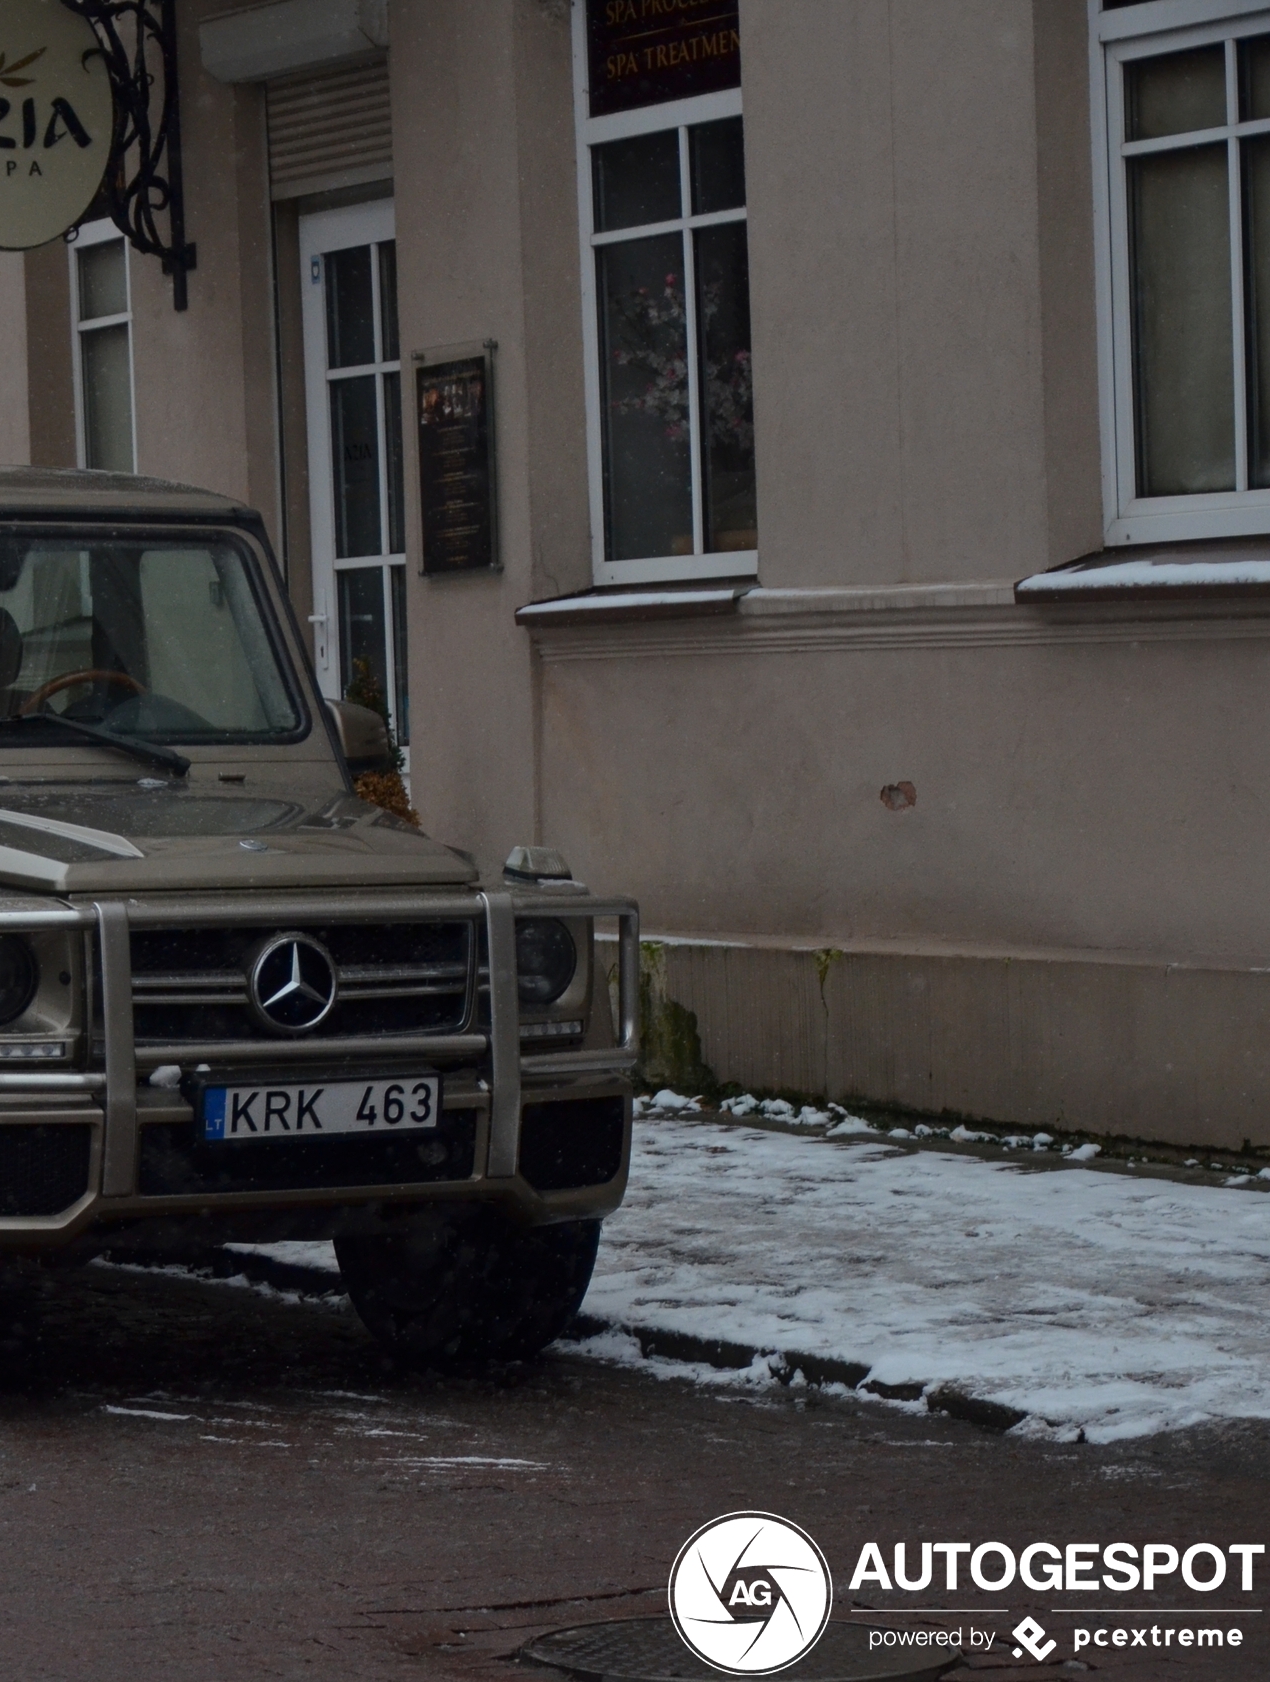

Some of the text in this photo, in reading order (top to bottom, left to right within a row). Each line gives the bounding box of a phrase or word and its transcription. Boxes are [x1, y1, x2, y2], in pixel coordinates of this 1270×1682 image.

[605, 0, 638, 26] SPA
[606, 52, 639, 79] SPA
[231, 1082, 432, 1133] KRK 463
[205, 1118, 222, 1131] LT
